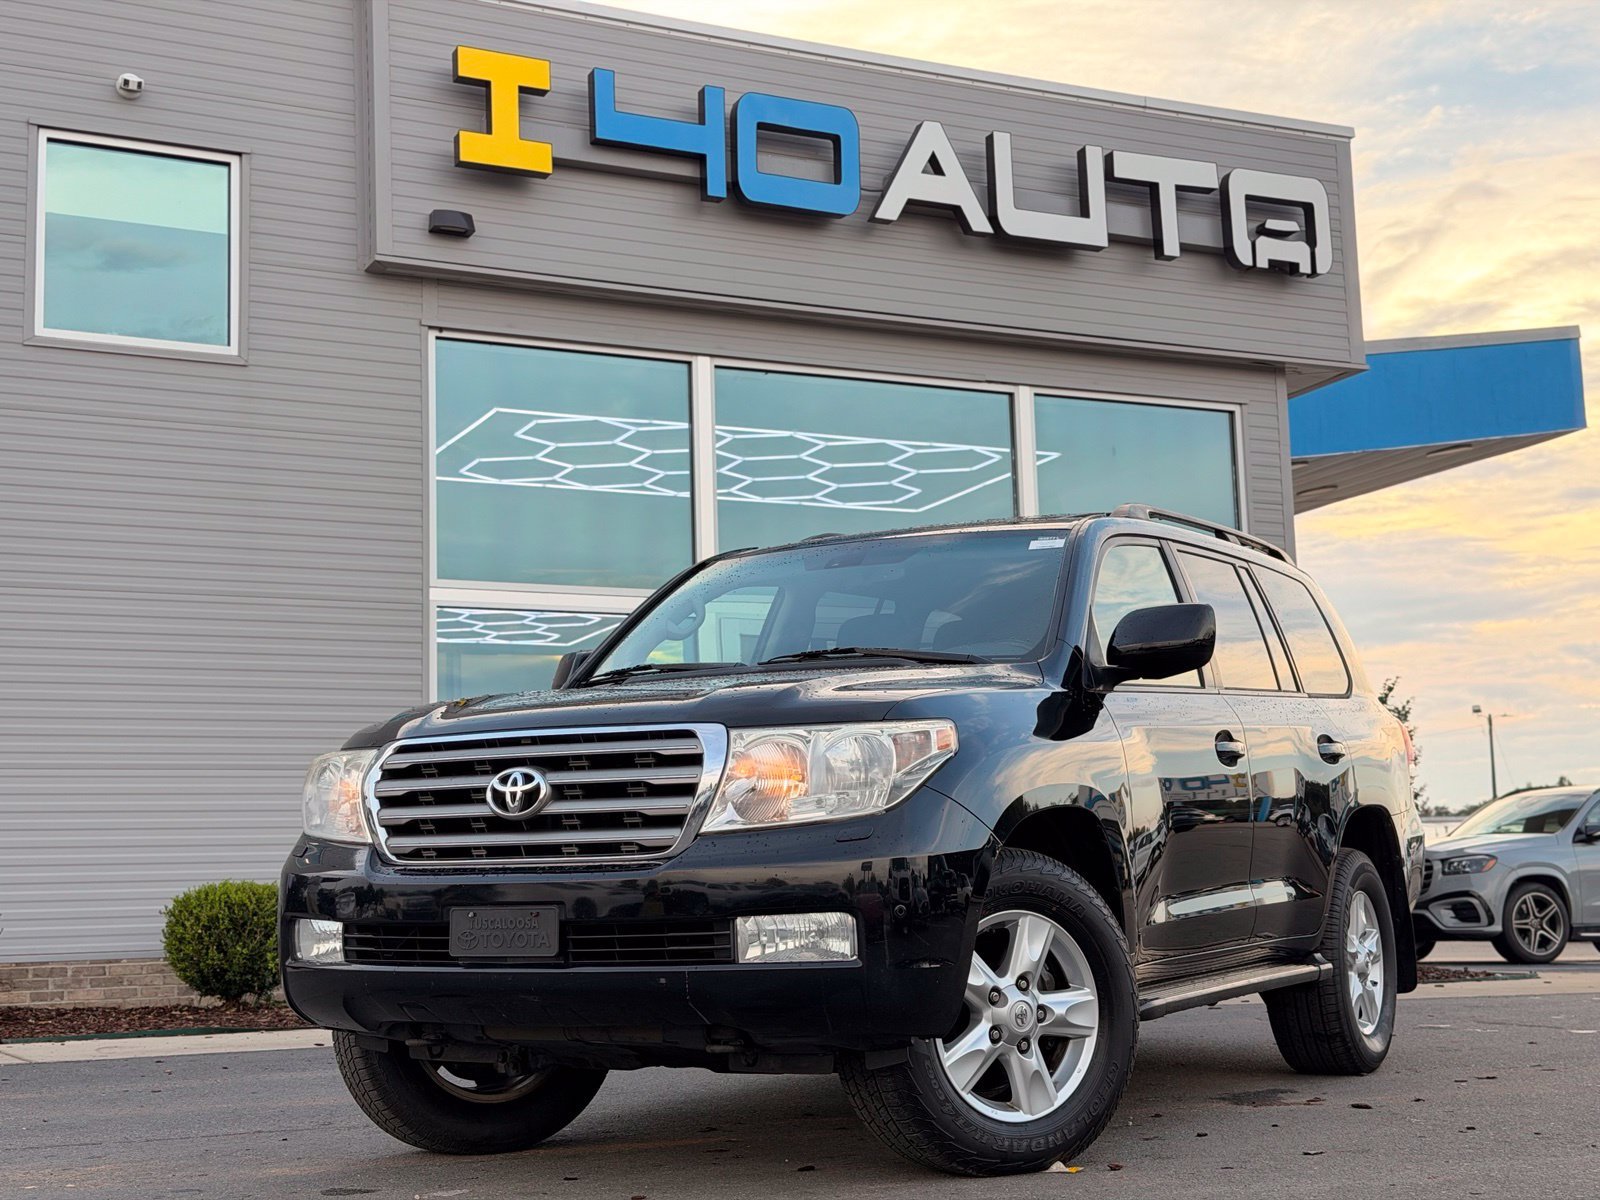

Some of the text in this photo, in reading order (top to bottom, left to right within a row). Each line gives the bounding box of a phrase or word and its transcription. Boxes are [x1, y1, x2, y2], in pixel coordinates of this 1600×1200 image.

[984, 879, 1088, 918] OKOHAMA
[470, 918, 540, 930] TUSCALOOSA
[480, 931, 551, 949] TOYOTA
